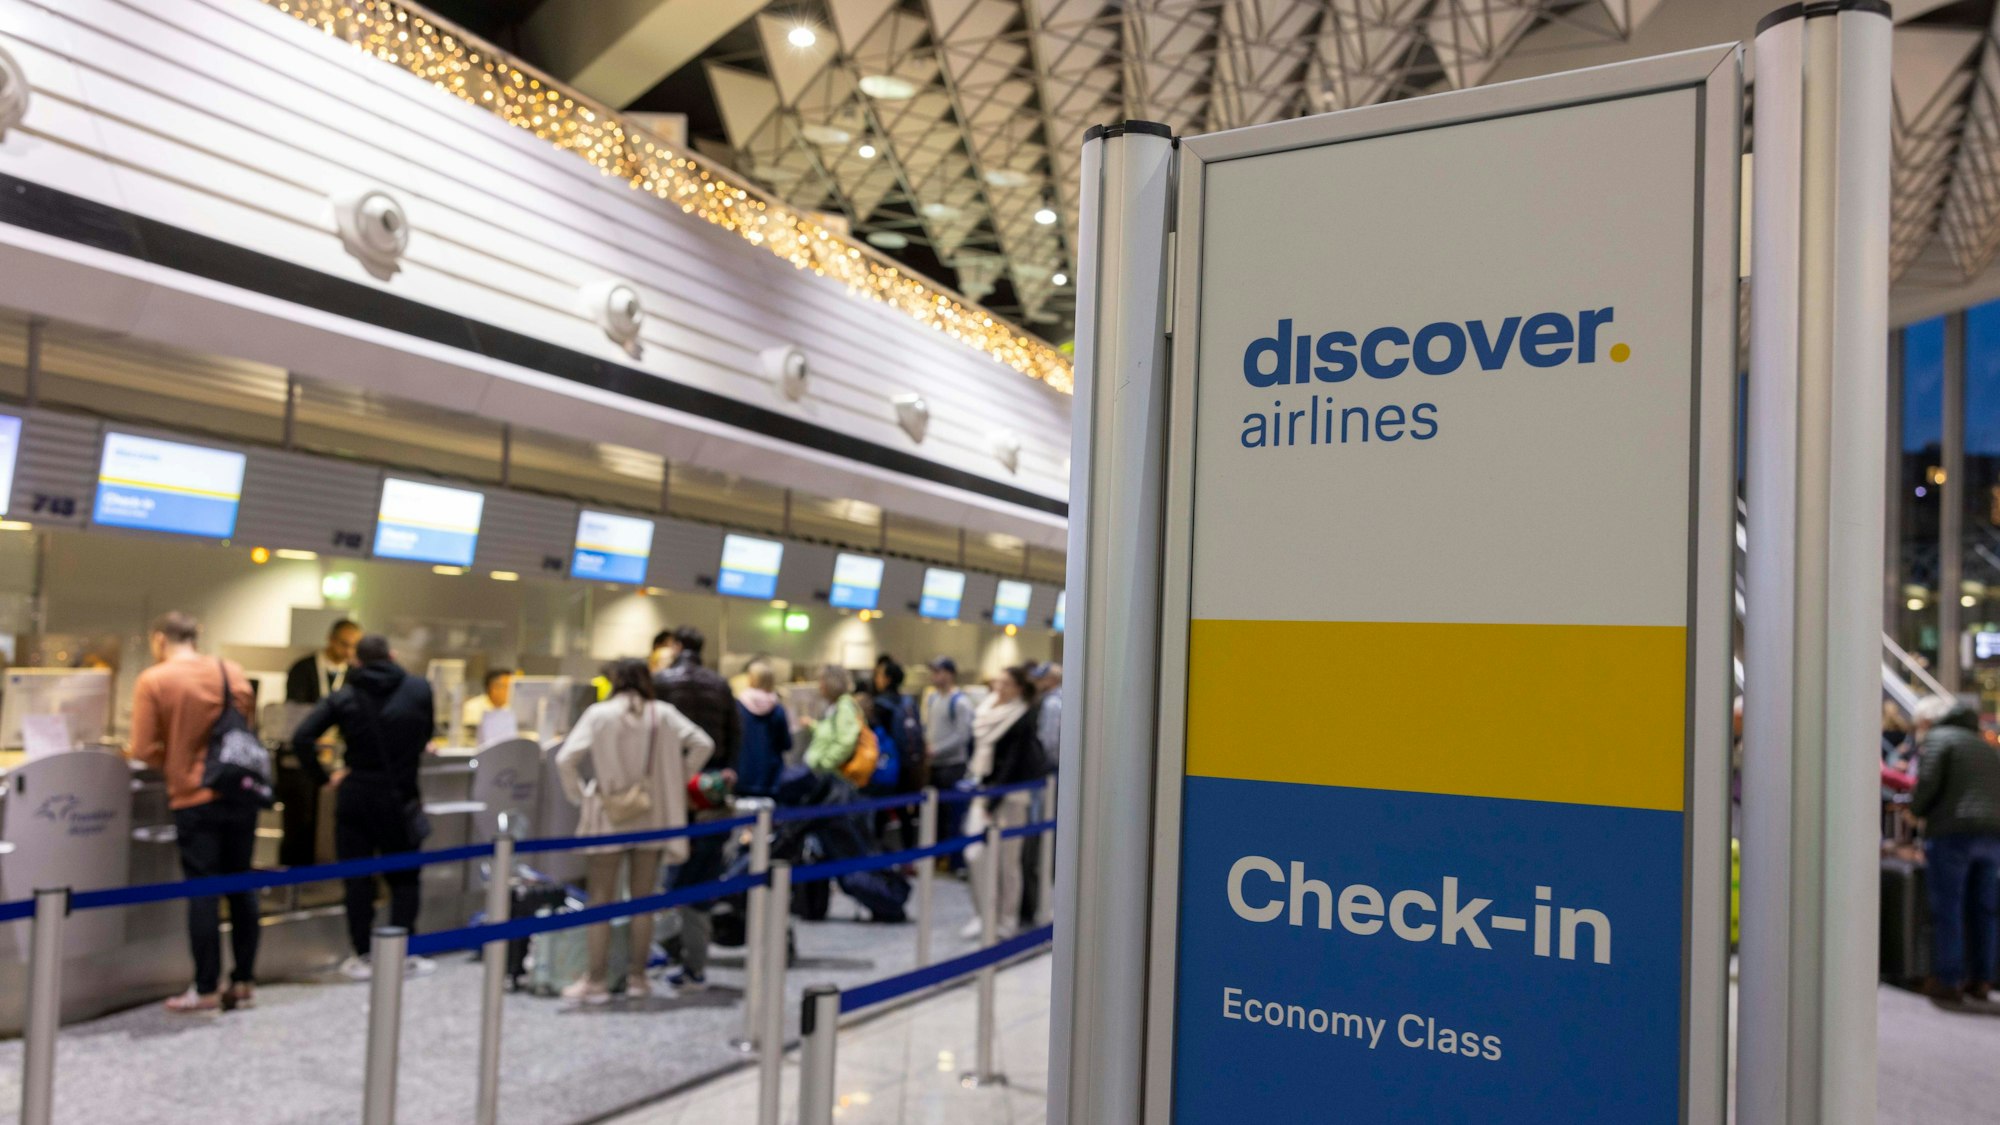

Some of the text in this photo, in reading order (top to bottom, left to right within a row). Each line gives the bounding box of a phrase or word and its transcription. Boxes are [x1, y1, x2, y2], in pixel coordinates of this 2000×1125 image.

[1240, 395, 1439, 449] airlines
[1226, 855, 1612, 965] Check-in
[1222, 986, 1503, 1062] Economy Class
